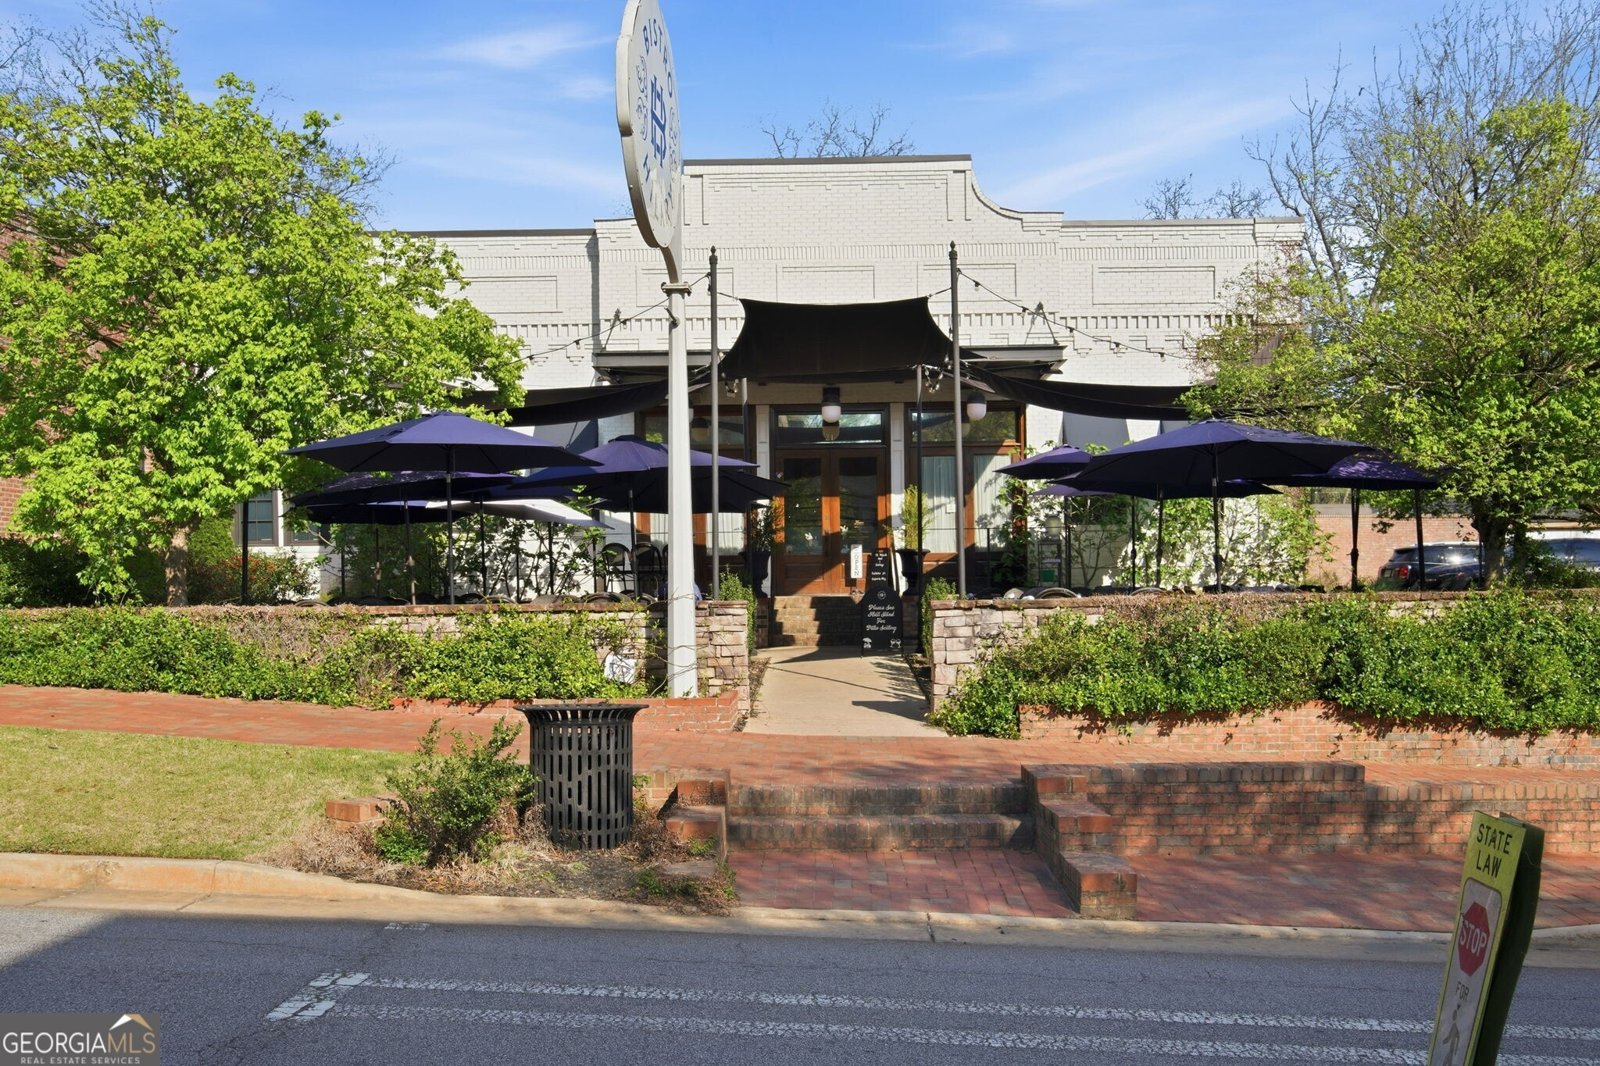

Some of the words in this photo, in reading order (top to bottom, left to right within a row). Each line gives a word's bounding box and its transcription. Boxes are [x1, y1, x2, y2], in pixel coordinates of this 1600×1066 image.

[642, 18, 673, 98] BISTRO
[1476, 823, 1513, 856] STATE
[1476, 856, 1502, 880] LAW
[1459, 923, 1488, 957] STOP
[1455, 981, 1470, 1003] FOR
